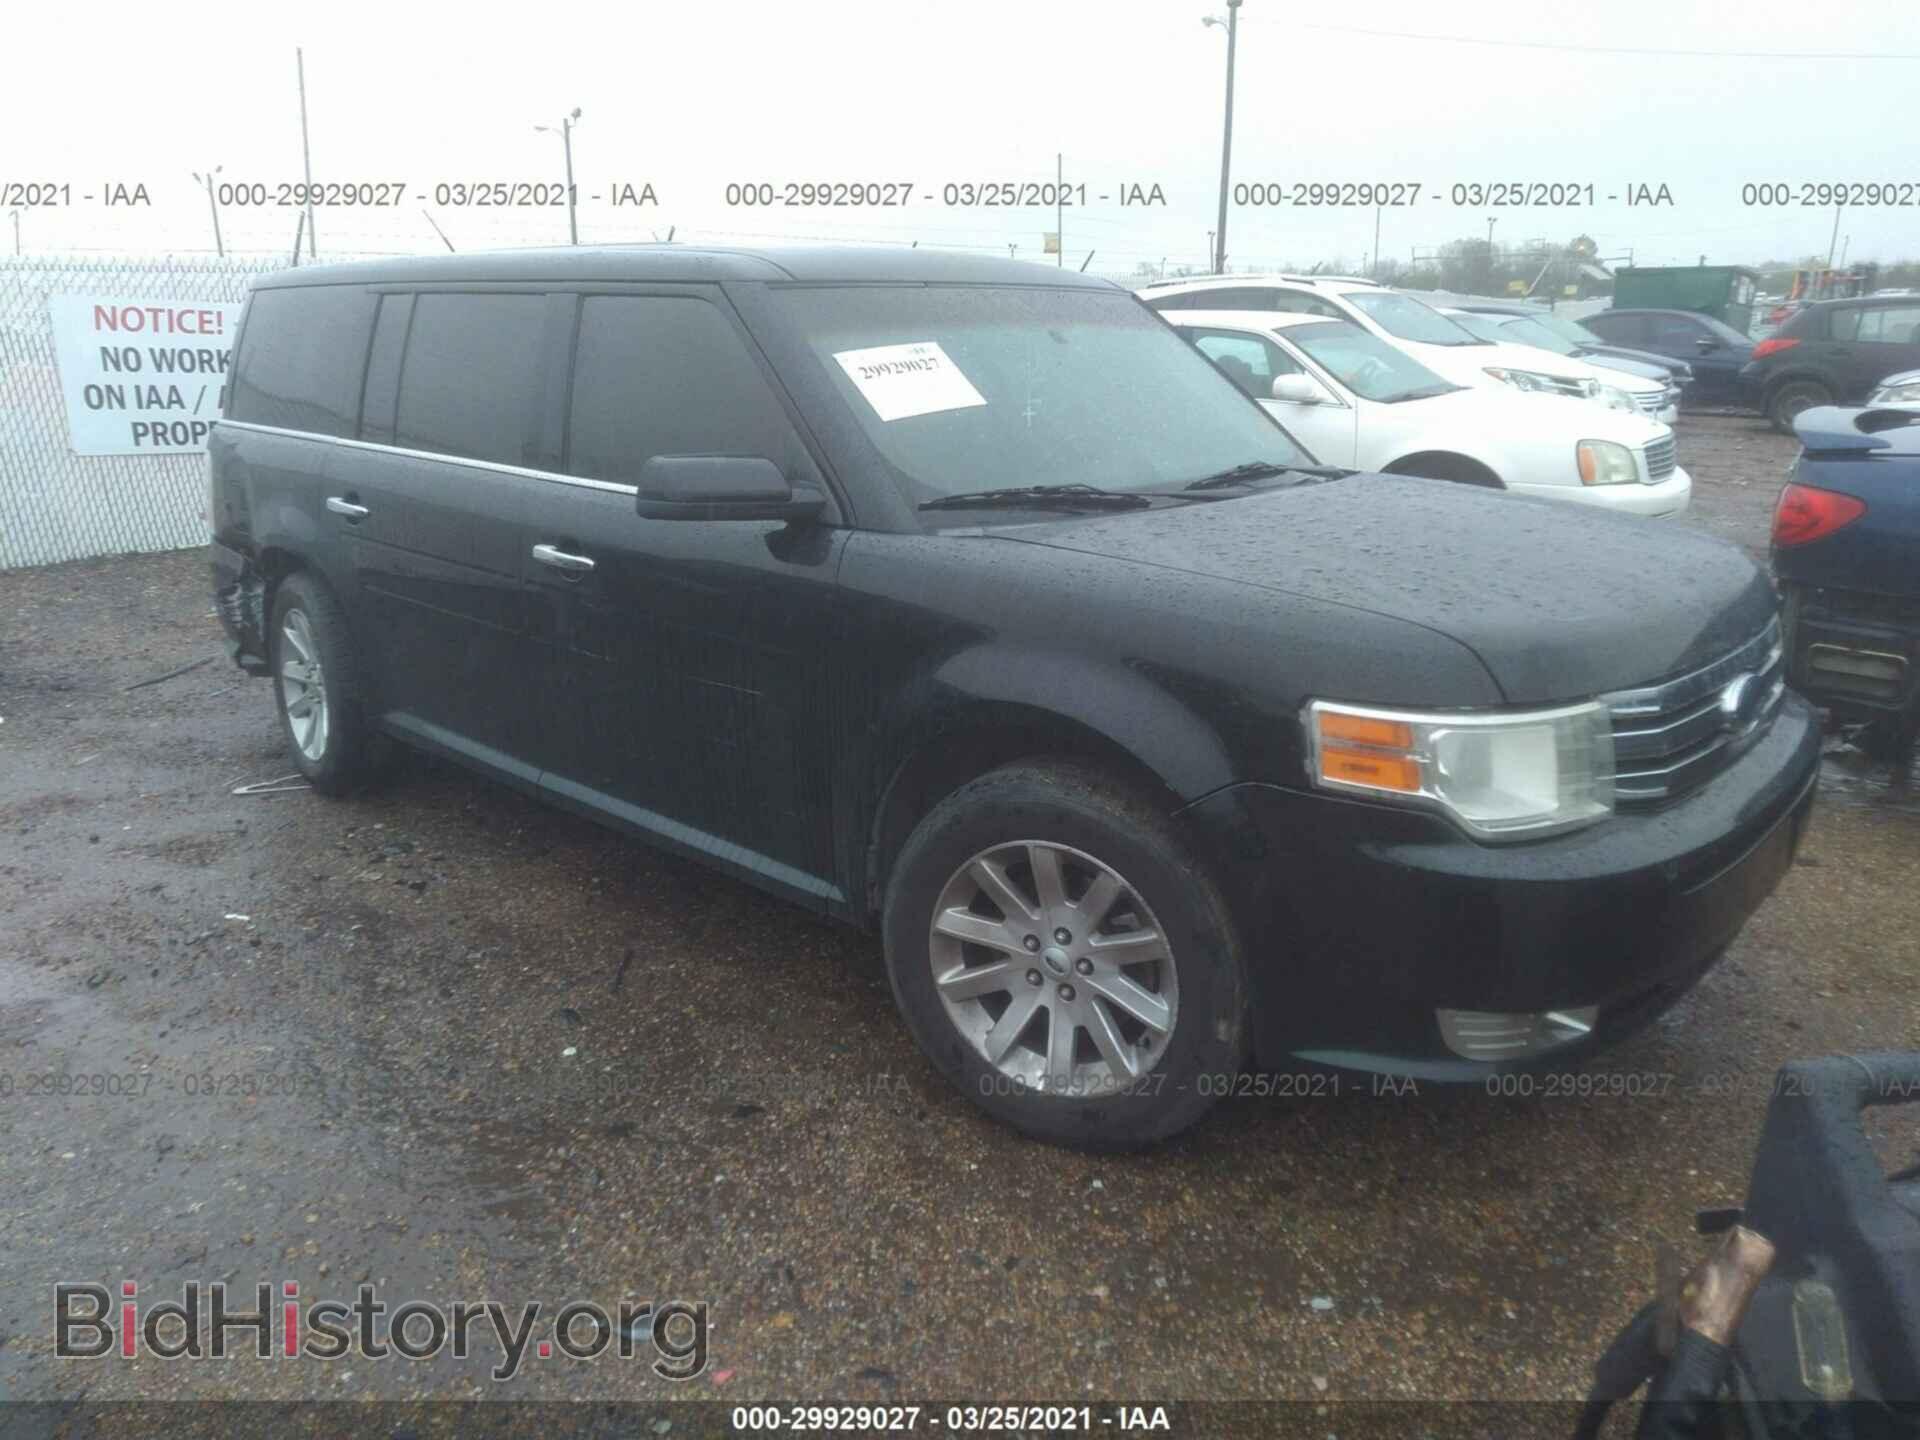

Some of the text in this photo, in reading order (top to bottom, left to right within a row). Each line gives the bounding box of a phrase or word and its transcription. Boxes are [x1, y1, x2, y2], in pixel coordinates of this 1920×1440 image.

[93, 304, 224, 336] NOTICE!
[100, 345, 232, 374] NO WORK
[83, 383, 127, 411] ON
[133, 384, 187, 411] IAA
[130, 420, 218, 448] PROP
